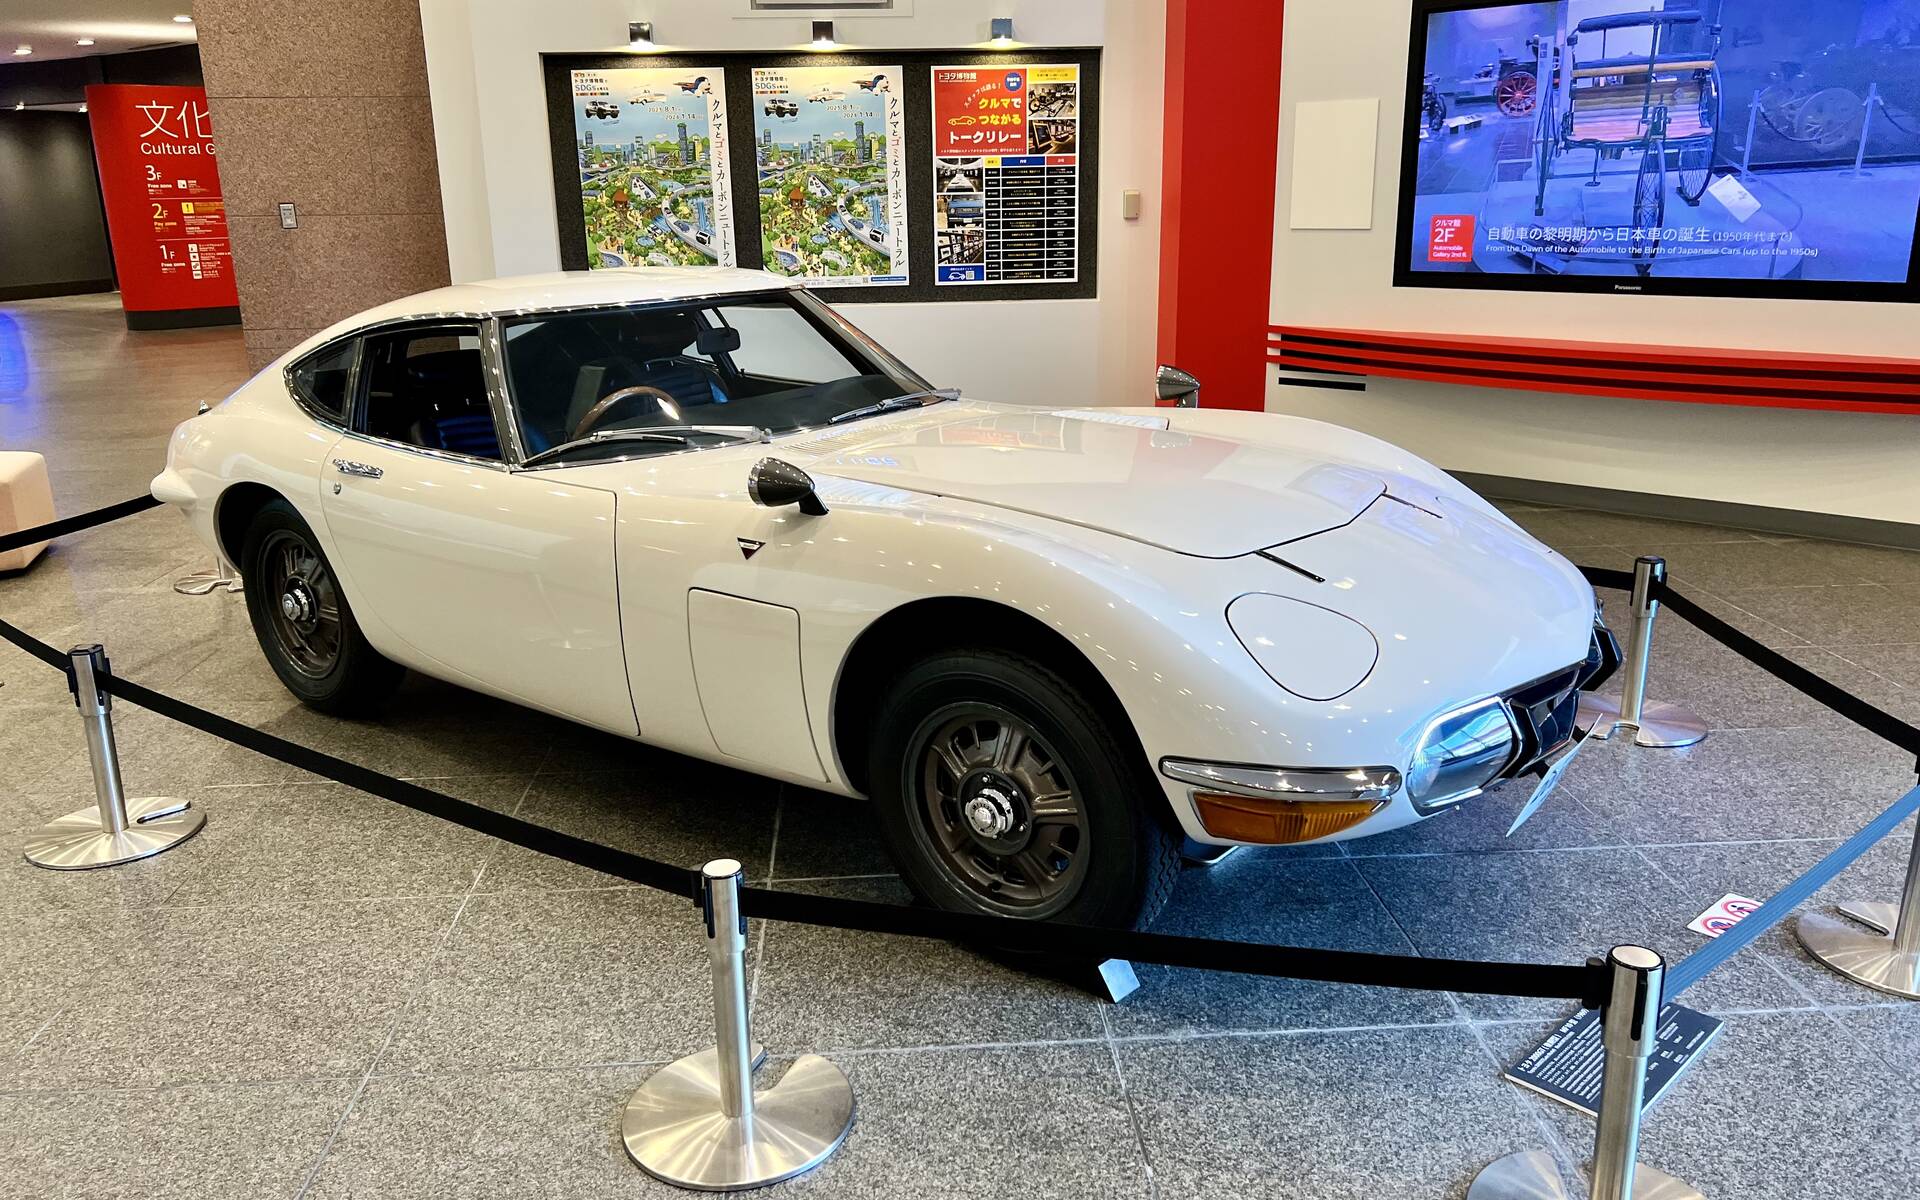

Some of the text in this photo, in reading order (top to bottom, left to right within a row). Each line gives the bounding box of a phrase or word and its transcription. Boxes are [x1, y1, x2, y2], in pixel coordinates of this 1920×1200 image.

[938, 72, 977, 80] トヨタ博物館
[978, 97, 1021, 109] クルマで
[978, 114, 1022, 126] つながる
[949, 130, 1022, 145] トークリレー
[140, 142, 201, 155] Cultural
[144, 164, 163, 182] 3F
[889, 97, 906, 269] クルマとゴミとカーボンニュートラル
[151, 202, 169, 219] 2F
[1436, 219, 1462, 228] クルマ館
[1433, 227, 1456, 243] 2F
[1488, 226, 1793, 242] 自動車の黎明期から日本車の誕生 (1950年代まで)
[159, 244, 176, 260] 1F
[1485, 244, 1505, 252] From
[1507, 244, 1520, 252] the
[1545, 244, 1554, 253] of
[1554, 245, 1568, 253] the
[1568, 245, 1617, 254] Automobile
[1628, 246, 1642, 254] the
[1644, 246, 1666, 254] Birth
[1667, 246, 1677, 254] of
[1677, 247, 1720, 256] Japanese
[1721, 247, 1741, 255] Cars
[1743, 247, 1758, 256] (up
[1760, 248, 1769, 256] to
[1771, 247, 1788, 256] the
[1790, 247, 1819, 257] 1950s)
